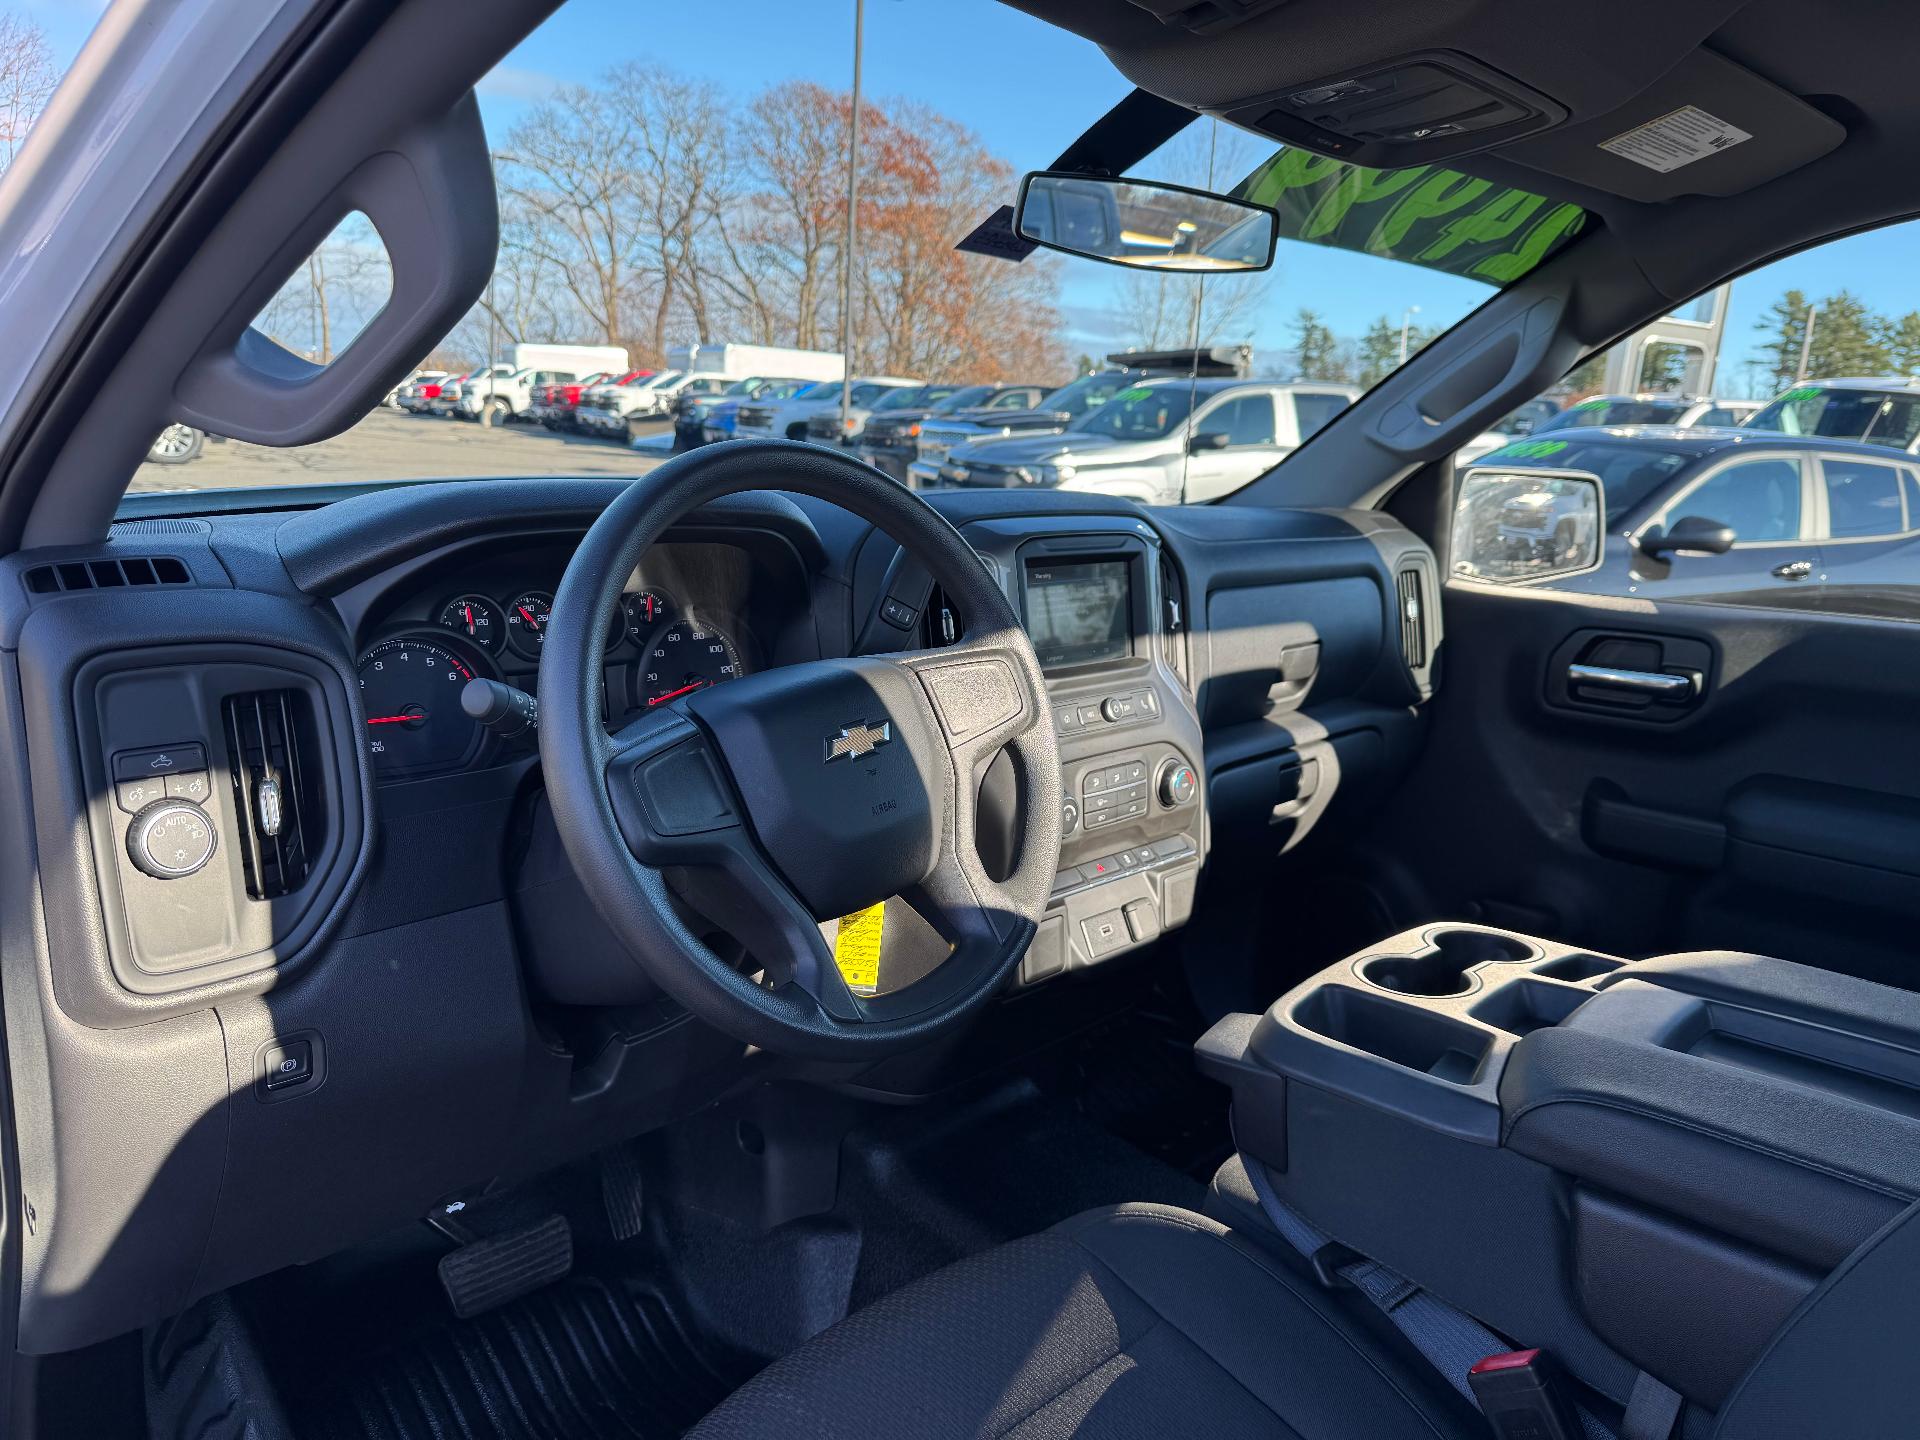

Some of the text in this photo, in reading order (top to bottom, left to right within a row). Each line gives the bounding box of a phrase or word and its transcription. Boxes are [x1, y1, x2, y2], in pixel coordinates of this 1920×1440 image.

[475, 618, 489, 626] 120
[509, 616, 521, 624] 160
[668, 633, 680, 642] 60
[692, 632, 705, 640] 80
[709, 644, 724, 653] 100
[400, 652, 409, 662] 4
[375, 661, 384, 670] 3
[426, 658, 435, 667] 5
[720, 664, 734, 674] 120
[448, 672, 457, 681] 6
[648, 697, 655, 706] 0
[871, 799, 897, 816] AIRBAG
[165, 815, 187, 827] AUTO
